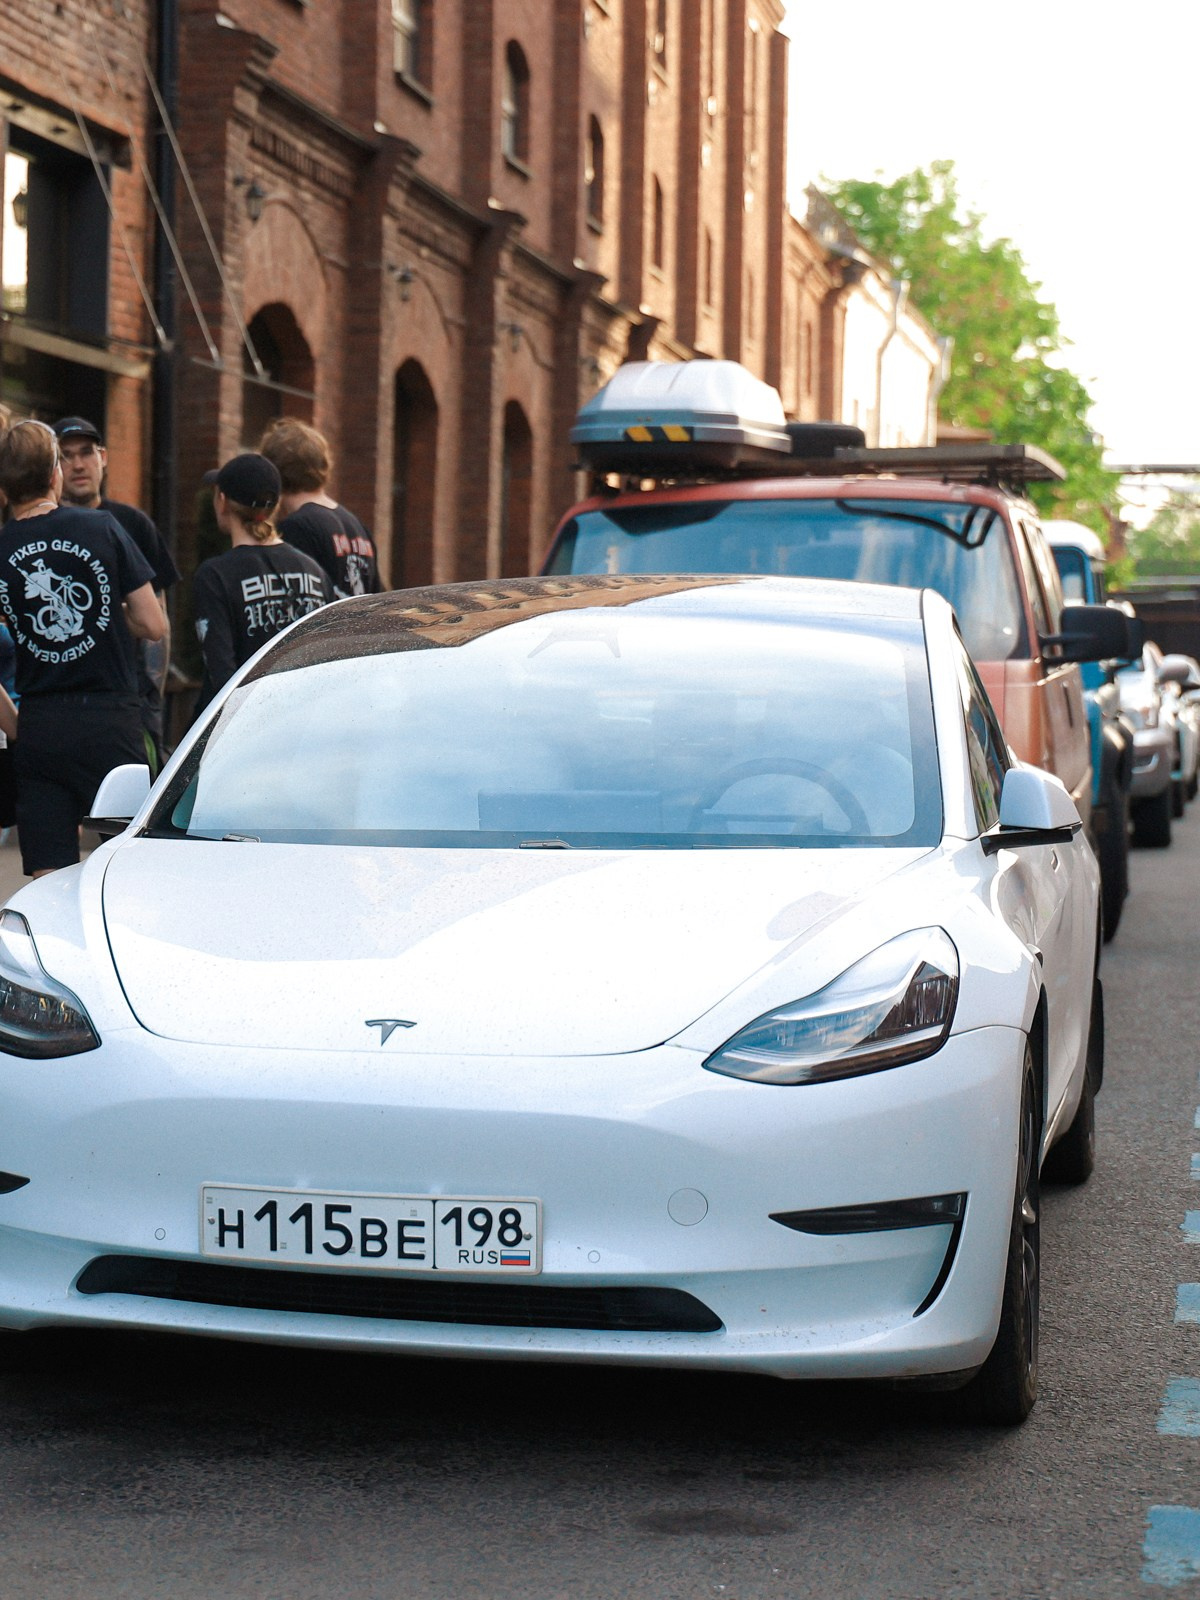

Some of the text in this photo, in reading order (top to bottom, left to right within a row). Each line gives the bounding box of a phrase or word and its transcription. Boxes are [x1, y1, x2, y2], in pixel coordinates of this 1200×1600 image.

[8, 539, 111, 632] FIXED GEAR MOSCOW
[27, 640, 60, 664] GEAR
[61, 635, 96, 663] FIXED
[441, 1206, 523, 1247] 198
[458, 1249, 498, 1265] RUS
